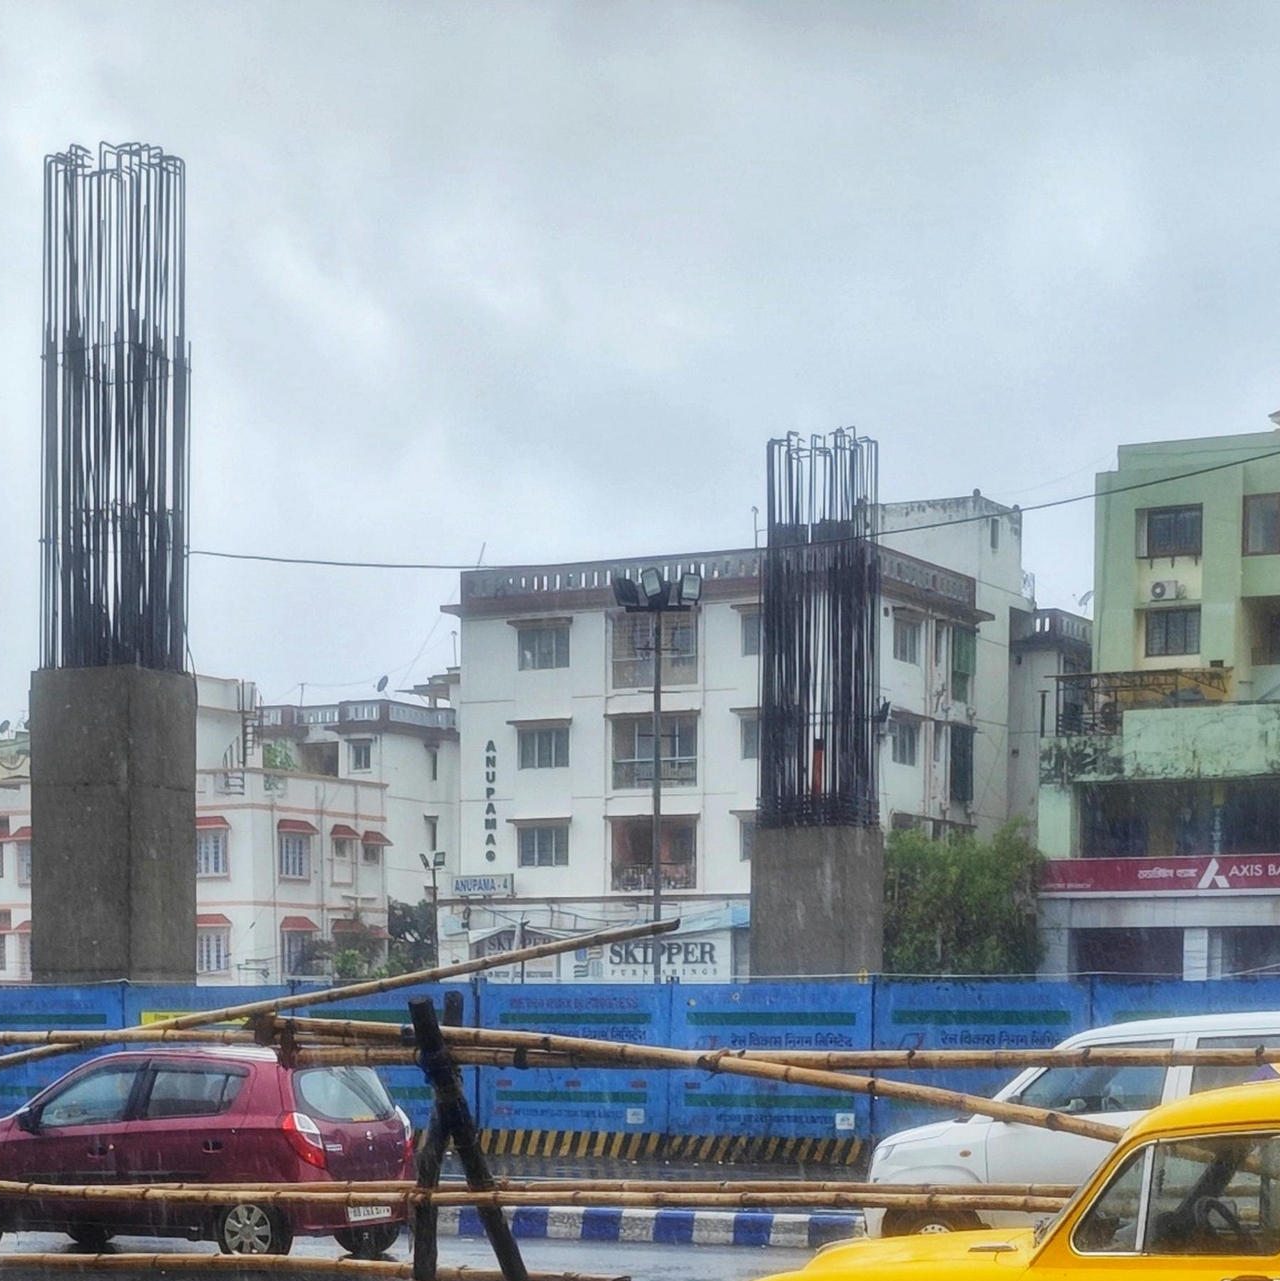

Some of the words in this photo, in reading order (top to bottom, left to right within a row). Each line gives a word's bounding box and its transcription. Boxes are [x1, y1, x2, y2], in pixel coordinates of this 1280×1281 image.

[484, 739, 497, 846] ANUPAMA
[1228, 864, 1263, 877] AXIS
[454, 878, 496, 892] ANUPAMA
